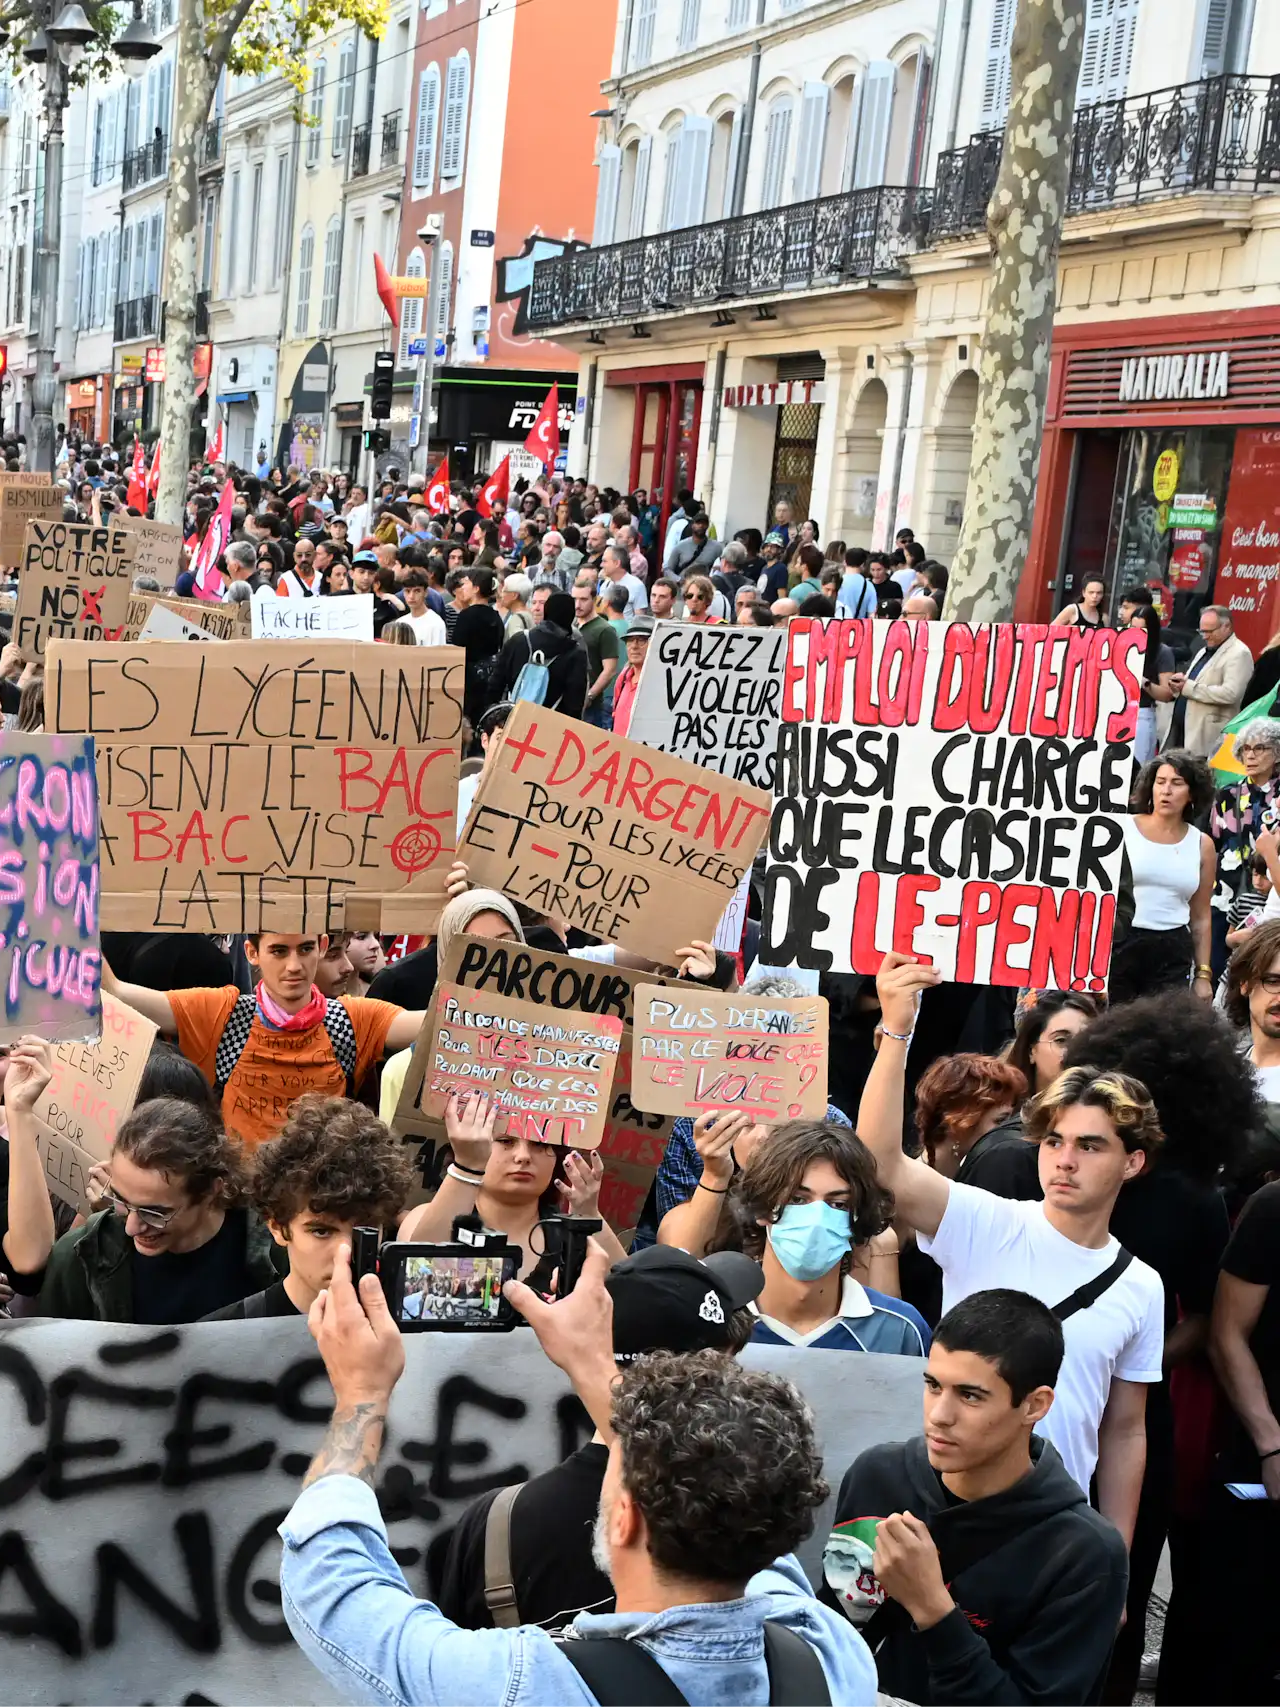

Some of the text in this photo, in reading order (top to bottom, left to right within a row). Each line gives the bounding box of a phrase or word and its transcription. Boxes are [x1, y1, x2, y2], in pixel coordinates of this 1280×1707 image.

[395, 281, 426, 292] Tabac
[1119, 352, 1228, 401] NATURALIA
[7, 490, 63, 507] BISMILLAH
[33, 522, 127, 554] VOTRE
[1232, 520, 1280, 547] C'est bon
[1229, 588, 1256, 612] sain
[659, 631, 764, 672] GAZEZ
[56, 655, 464, 745] LES LYCÉEN.NES
[781, 617, 1150, 744] EMPLOI DU TEMPS
[672, 712, 770, 750] PAS LES
[262, 744, 457, 820] LE BAC
[774, 722, 900, 801] AUSSI
[545, 729, 772, 851] D'ARGENT
[523, 781, 746, 890] POUR LES LYCÉES
[769, 797, 1126, 892] QUE LE CASIER
[466, 805, 541, 859] ET
[562, 841, 651, 910] POUR
[153, 861, 357, 935] LA TÊTE
[502, 865, 631, 941] L'ARMÉE
[758, 864, 840, 971] DE
[445, 998, 621, 1054] PARDON DE MANIFESTER
[647, 999, 718, 1030] PLUS
[56, 1042, 116, 1090] ÉLÈVES
[109, 1046, 129, 1072] 35
[438, 1030, 472, 1054] POUR
[478, 1032, 531, 1063] MES
[640, 1036, 685, 1061] PAR
[784, 1043, 825, 1065] QUE
[231, 1071, 269, 1087] OUR
[435, 1054, 599, 1097] PENDANT QUE LES
[650, 1064, 687, 1087] LE
[493, 1088, 599, 1114] MANGENT DES
[47, 1103, 84, 1146] POUR
